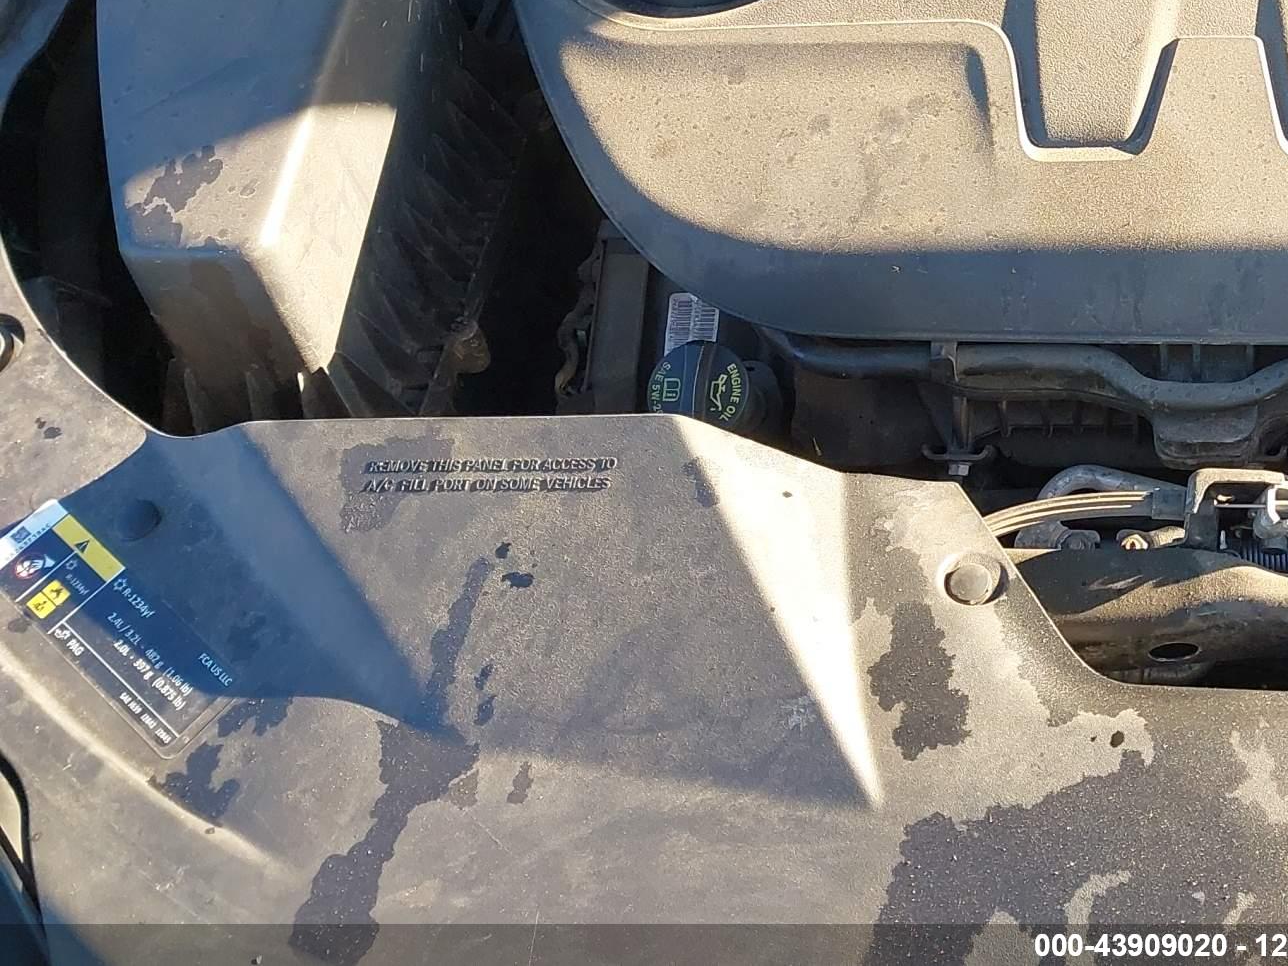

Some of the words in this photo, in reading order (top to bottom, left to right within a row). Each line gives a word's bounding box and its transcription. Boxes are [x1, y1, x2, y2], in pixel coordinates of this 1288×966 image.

[655, 361, 671, 383] SAE
[727, 363, 741, 404] ENGINE
[719, 405, 736, 421] OIL
[369, 459, 428, 472] REMOVE
[431, 458, 461, 472] THIS
[465, 458, 509, 471] PANEL
[512, 458, 542, 471] FOR
[543, 457, 596, 470] ACCESS
[600, 456, 619, 469] TO
[400, 478, 430, 491] FILL
[434, 477, 472, 491] PORT
[476, 477, 498, 491] ON
[499, 476, 541, 490] SOME
[544, 475, 612, 489] VEHICLES
[122, 588, 156, 618] R-1234yf
[66, 638, 85, 656] PAG
[198, 652, 213, 668] FCA
[210, 665, 223, 678] US
[218, 672, 233, 687] LLC
